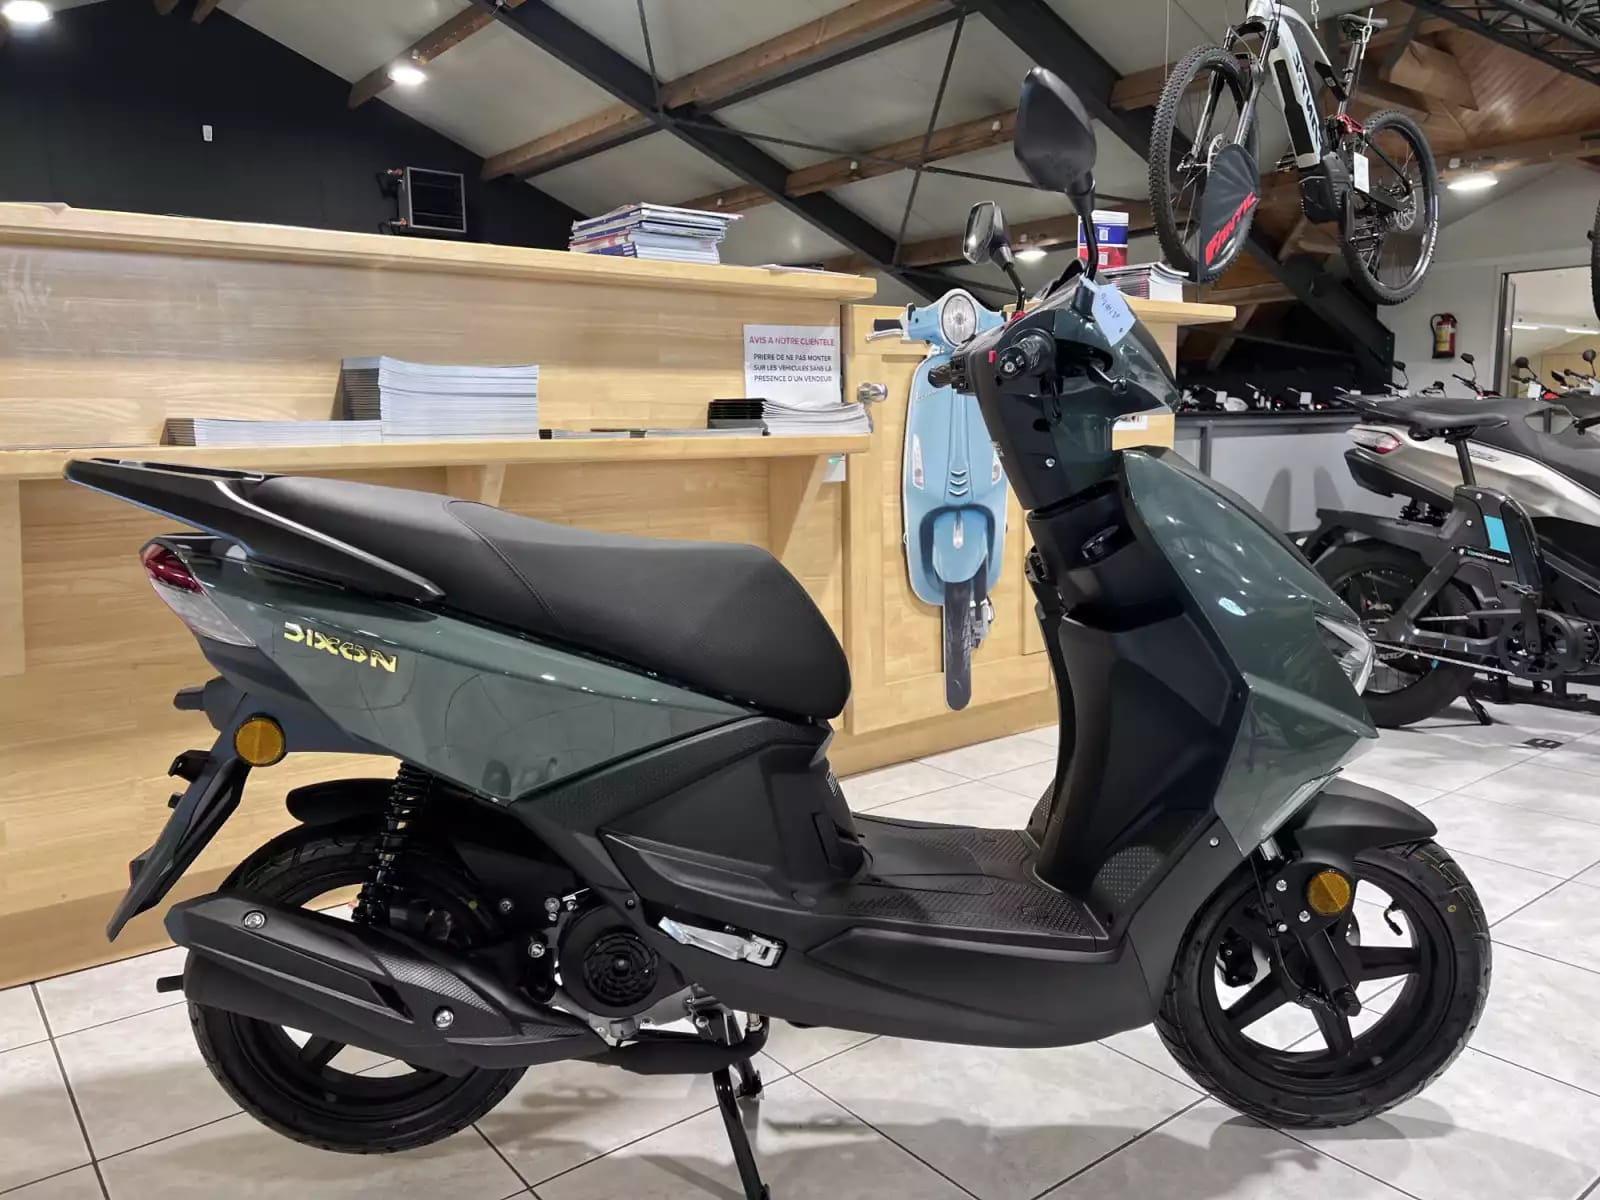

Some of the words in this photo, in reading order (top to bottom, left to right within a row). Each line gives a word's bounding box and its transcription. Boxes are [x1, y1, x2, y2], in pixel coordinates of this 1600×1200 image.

[749, 336, 766, 344] AVIS
[775, 337, 799, 345] NOTRE
[753, 353, 775, 361] PRIERE
[779, 364, 808, 372] VEHICULES
[283, 621, 397, 673] DIXON
